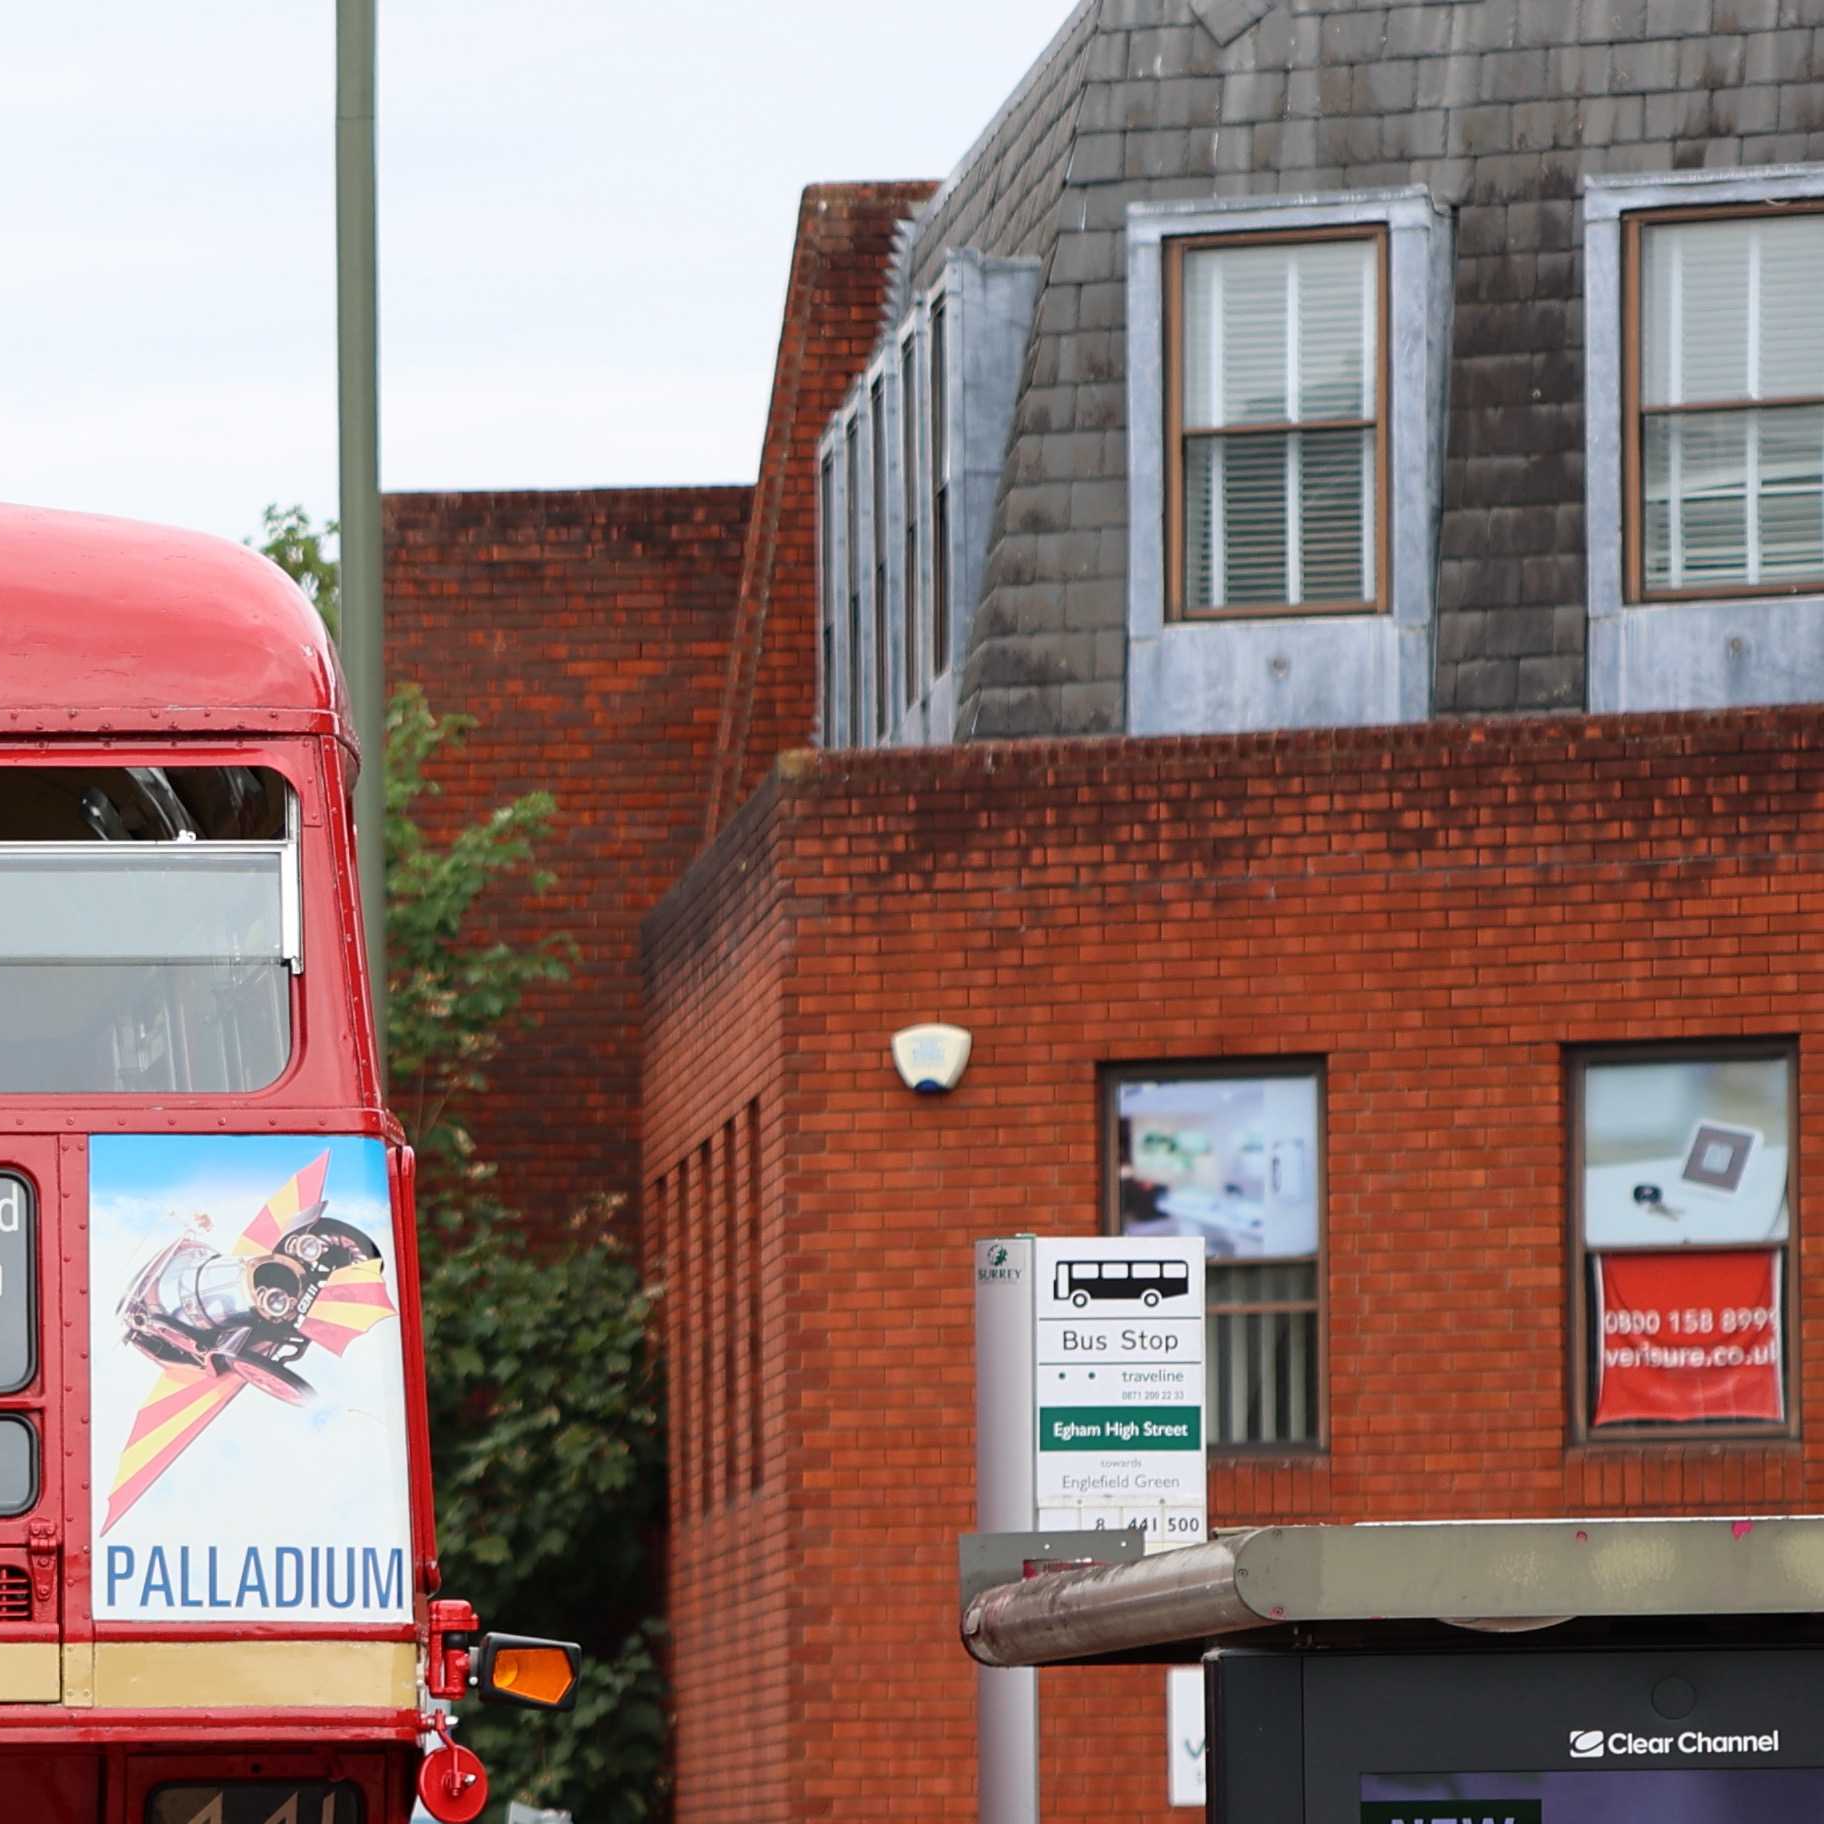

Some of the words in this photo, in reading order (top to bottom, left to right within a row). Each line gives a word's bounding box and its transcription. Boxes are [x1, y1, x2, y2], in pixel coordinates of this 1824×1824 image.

[977, 1268, 1022, 1281] SURREY
[1604, 1309, 1661, 1335] 0800
[1668, 1308, 1714, 1335] 158
[1062, 1330, 1108, 1351] Bus
[1120, 1329, 1179, 1354] Stop
[1121, 1369, 1185, 1383] traveline
[1053, 1421, 1101, 1441] Egham
[1104, 1421, 1140, 1441] High
[1143, 1420, 1189, 1437] Street
[1062, 1475, 1130, 1492] Englefield
[1134, 1474, 1180, 1489] Green
[1128, 1517, 1158, 1532] 441
[1167, 1517, 1200, 1532] 500
[105, 1545, 405, 1610] PALLADIUM
[1608, 1733, 1675, 1755] Clear
[1677, 1730, 1780, 1754] Channel
